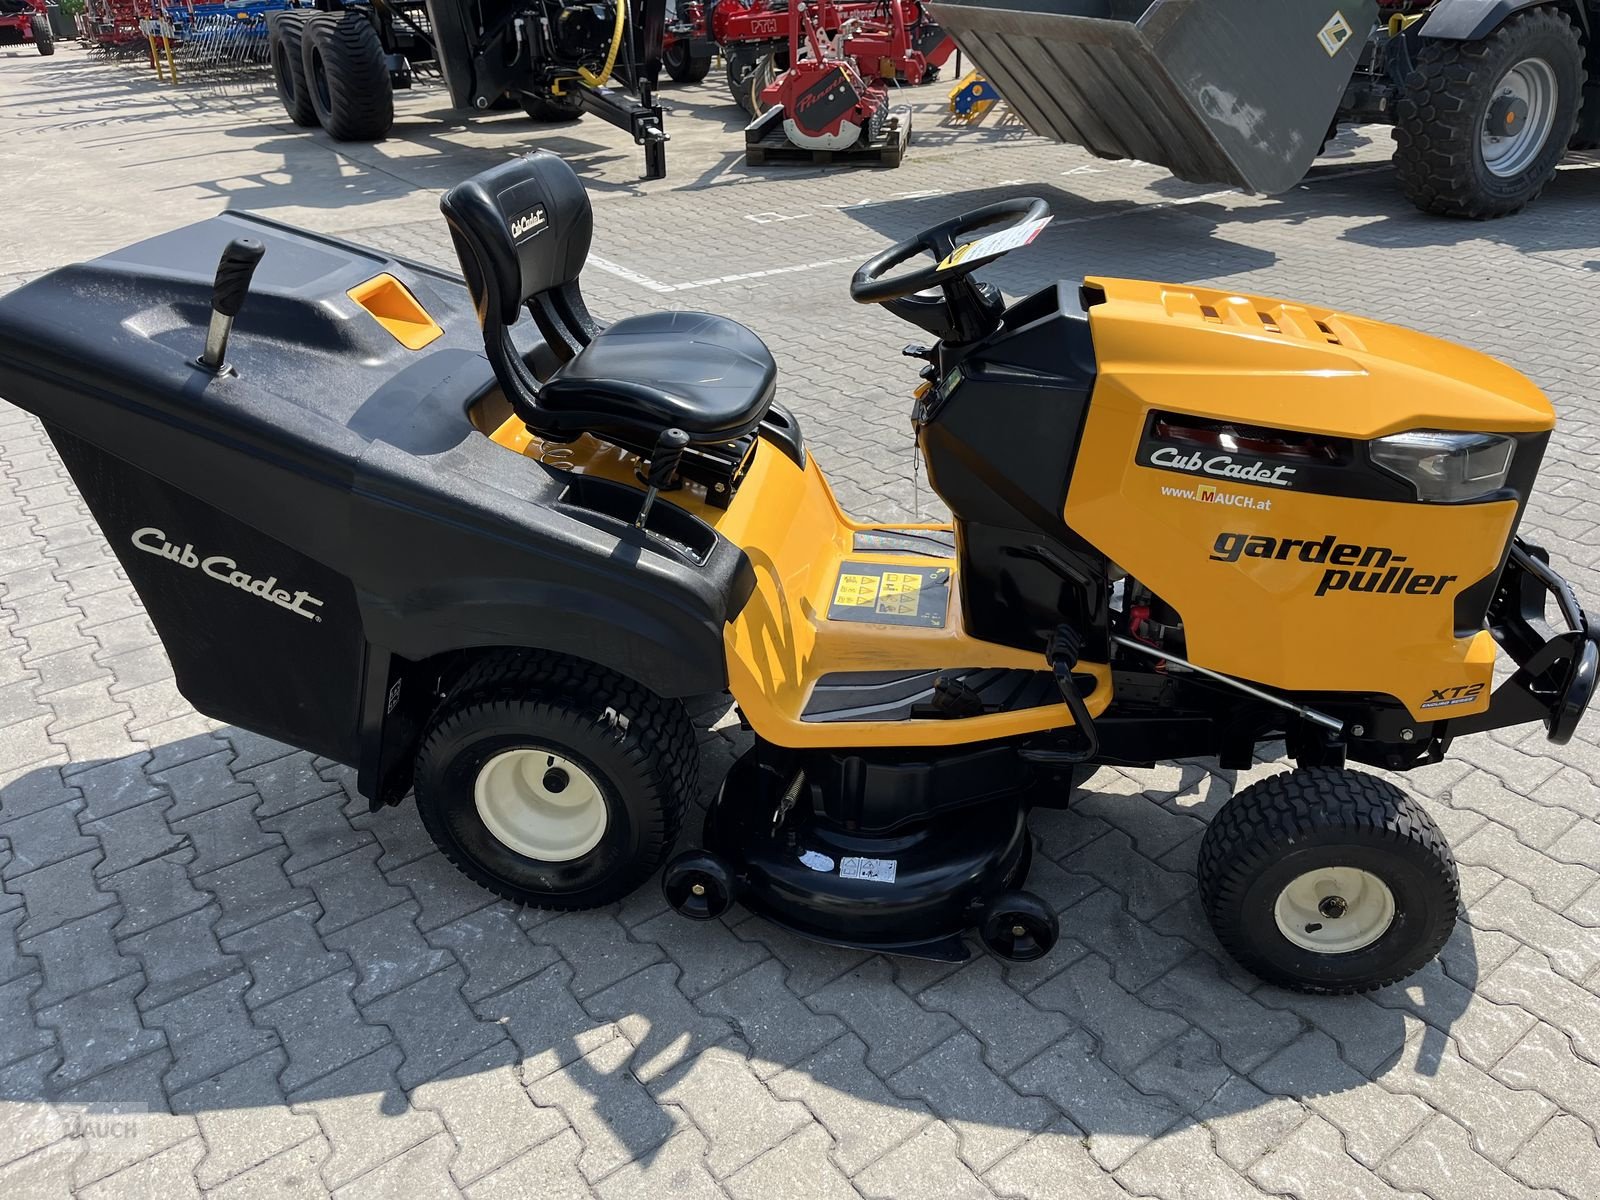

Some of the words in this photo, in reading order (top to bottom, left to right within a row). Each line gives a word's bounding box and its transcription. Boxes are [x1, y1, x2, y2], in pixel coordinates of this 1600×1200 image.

[751, 18, 777, 34] PTH
[1150, 447, 1203, 471] Cub
[1203, 456, 1297, 486] Cadet
[1161, 485, 1272, 511] www.MAUCH.at
[131, 527, 199, 569] Cub
[1209, 532, 1407, 568] garden-
[1314, 567, 1458, 597] puller
[1424, 683, 1485, 702] XT2
